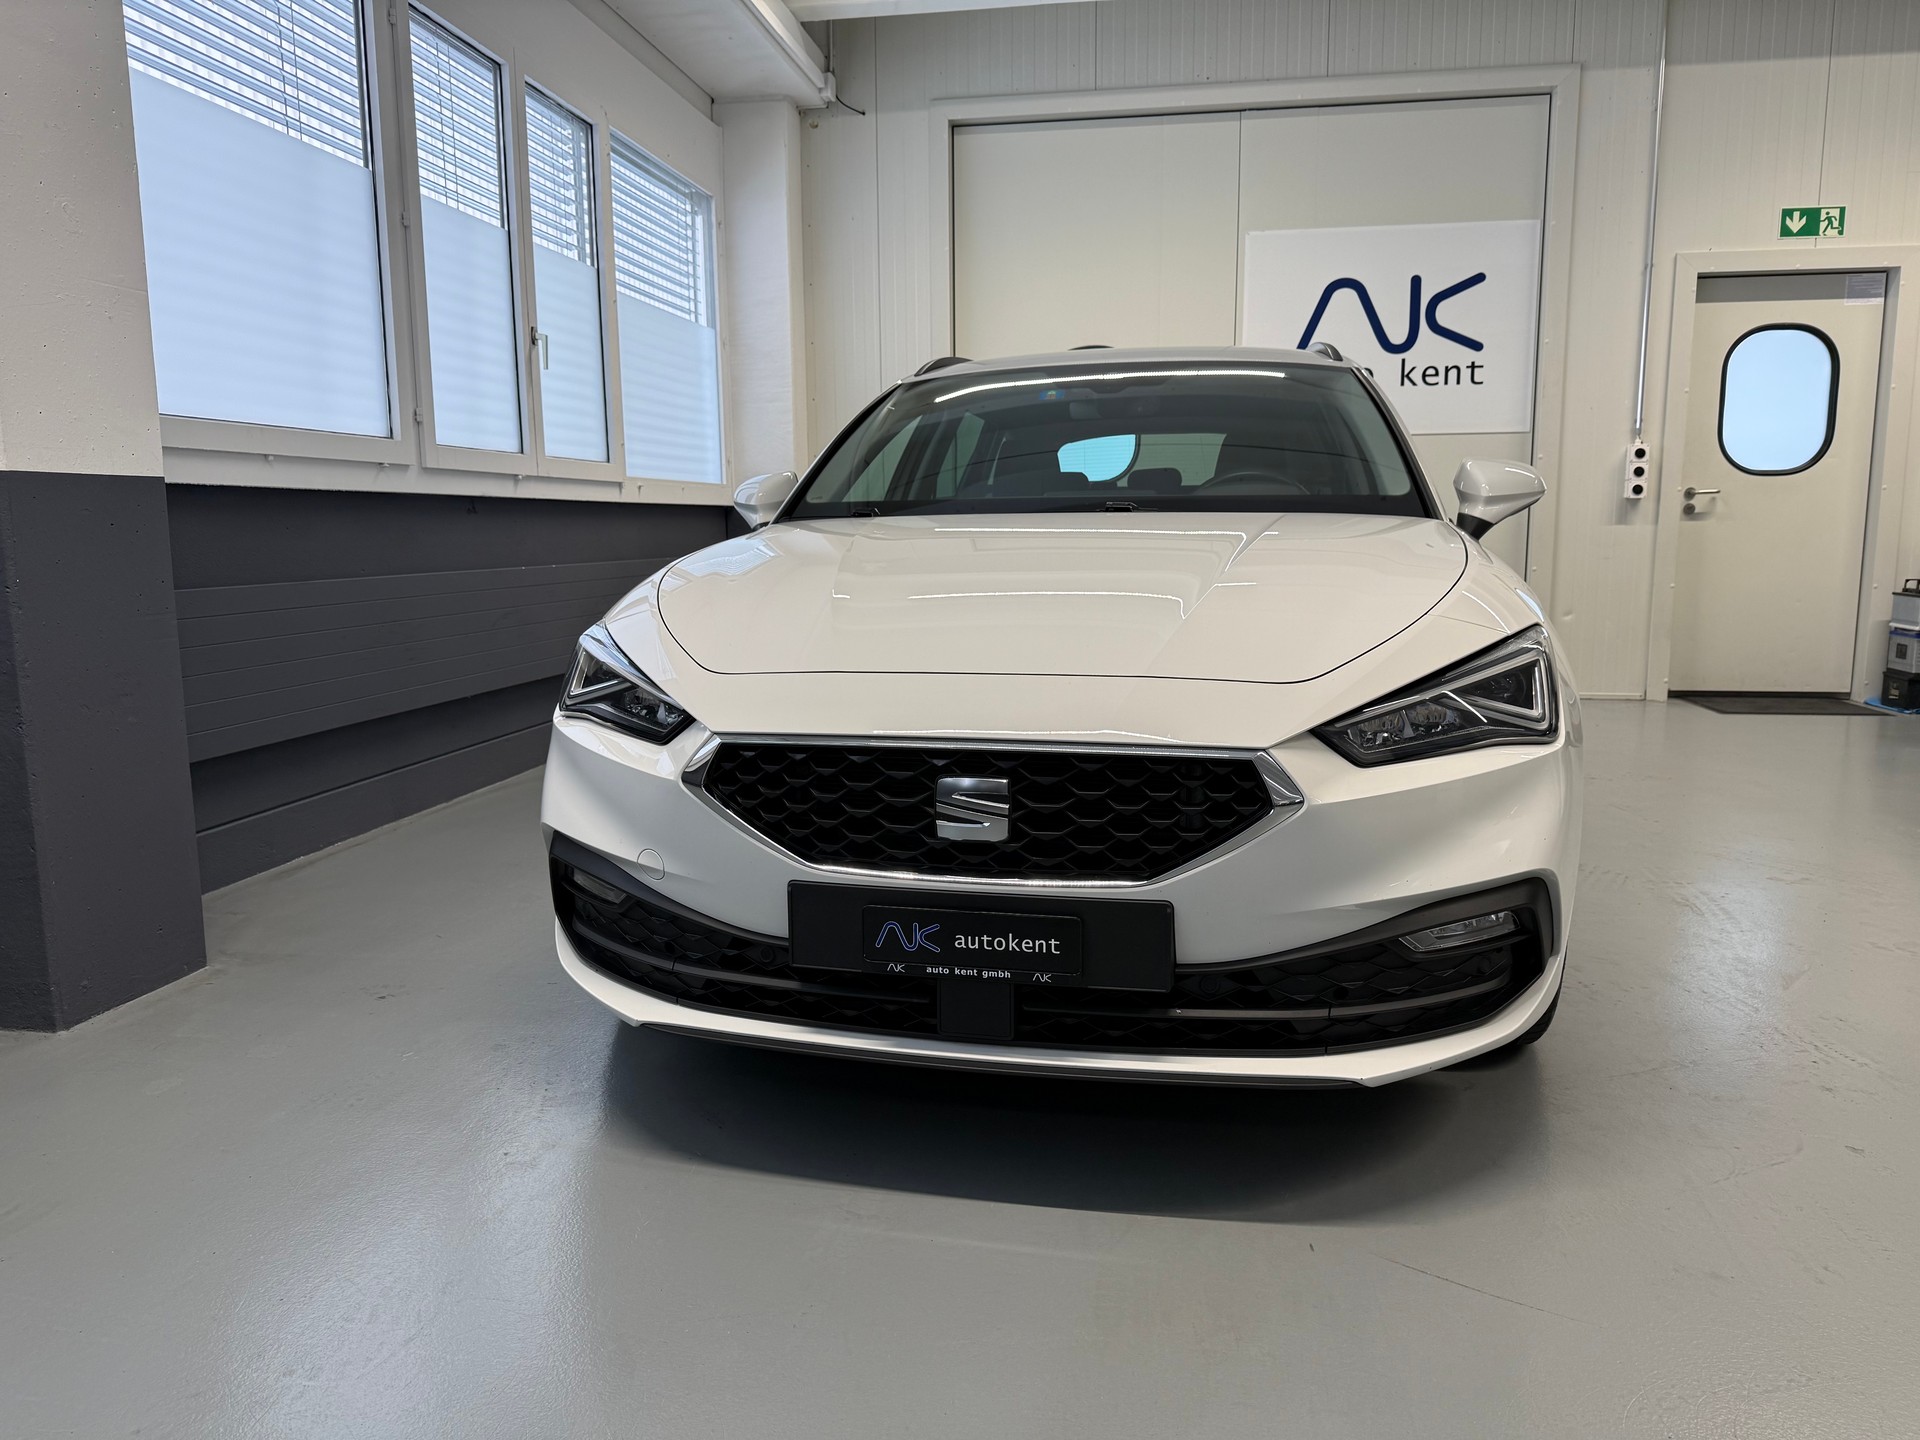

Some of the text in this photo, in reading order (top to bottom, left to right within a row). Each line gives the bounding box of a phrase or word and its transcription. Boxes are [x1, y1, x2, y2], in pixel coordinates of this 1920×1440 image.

[1400, 358, 1484, 387] kent
[954, 933, 1061, 954] autokent
[926, 966, 950, 975] auto
[954, 967, 978, 977] kent
[982, 970, 1011, 979] gmbh
